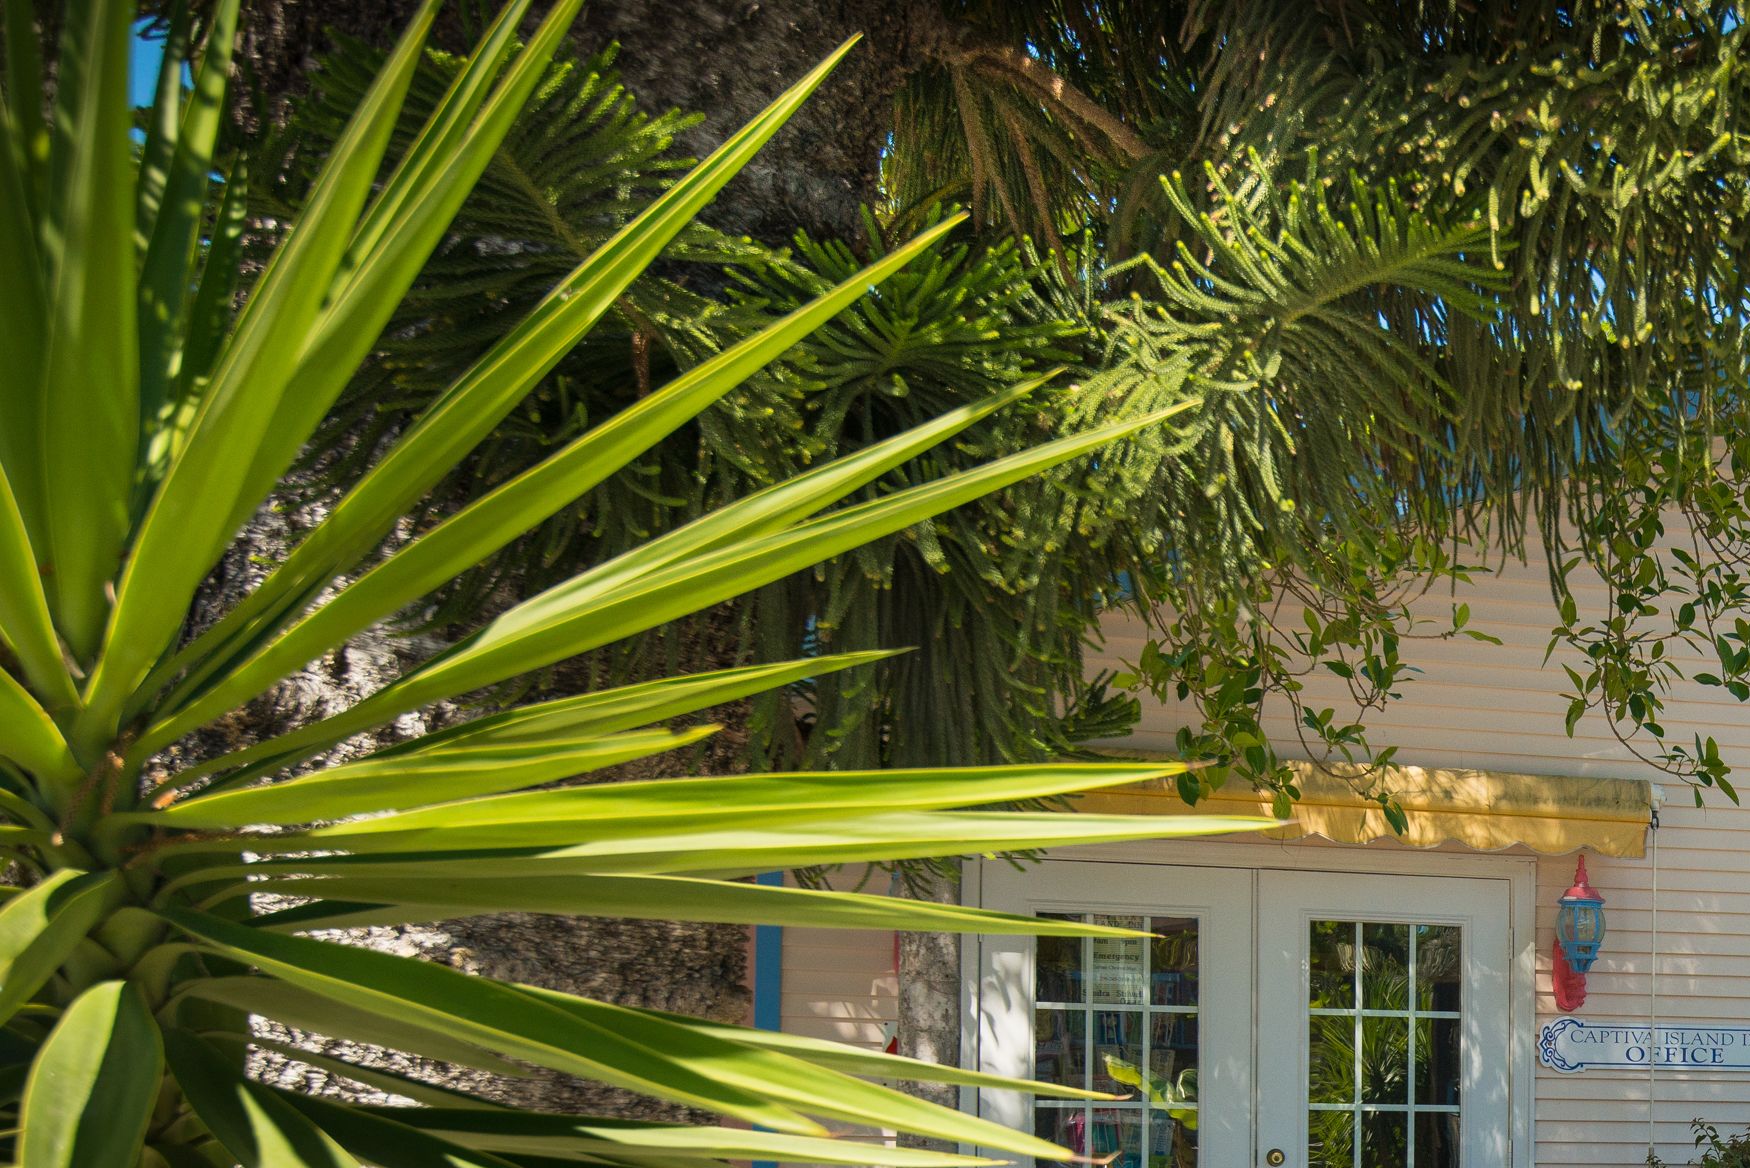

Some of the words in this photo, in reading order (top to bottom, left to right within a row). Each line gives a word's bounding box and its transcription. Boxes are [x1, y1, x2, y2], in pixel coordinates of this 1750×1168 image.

[1570, 1030, 1657, 1045] CAPTIVA
[1664, 1032, 1734, 1047] ISLAND
[1625, 1046, 1724, 1064] OFFICE
